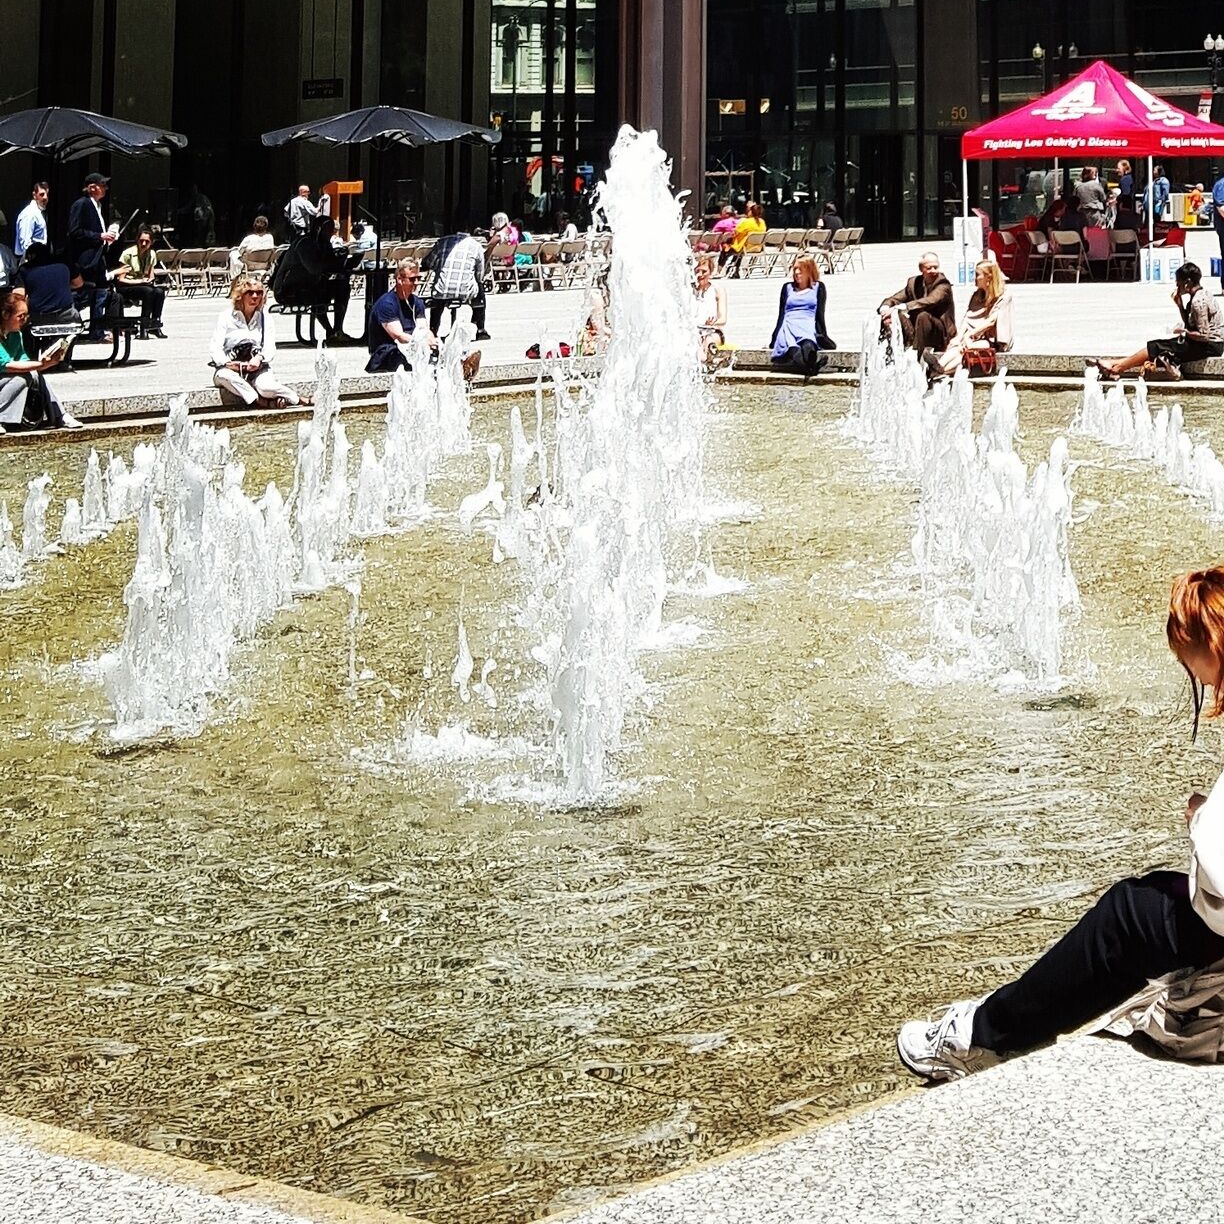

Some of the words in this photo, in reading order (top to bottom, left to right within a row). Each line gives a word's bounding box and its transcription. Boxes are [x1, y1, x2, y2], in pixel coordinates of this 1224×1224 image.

[951, 105, 968, 120] 50
[983, 138, 1023, 151] Fighting
[1024, 137, 1044, 148] Lou
[1045, 136, 1087, 148] Gehrig's
[1087, 136, 1129, 147] Disease
